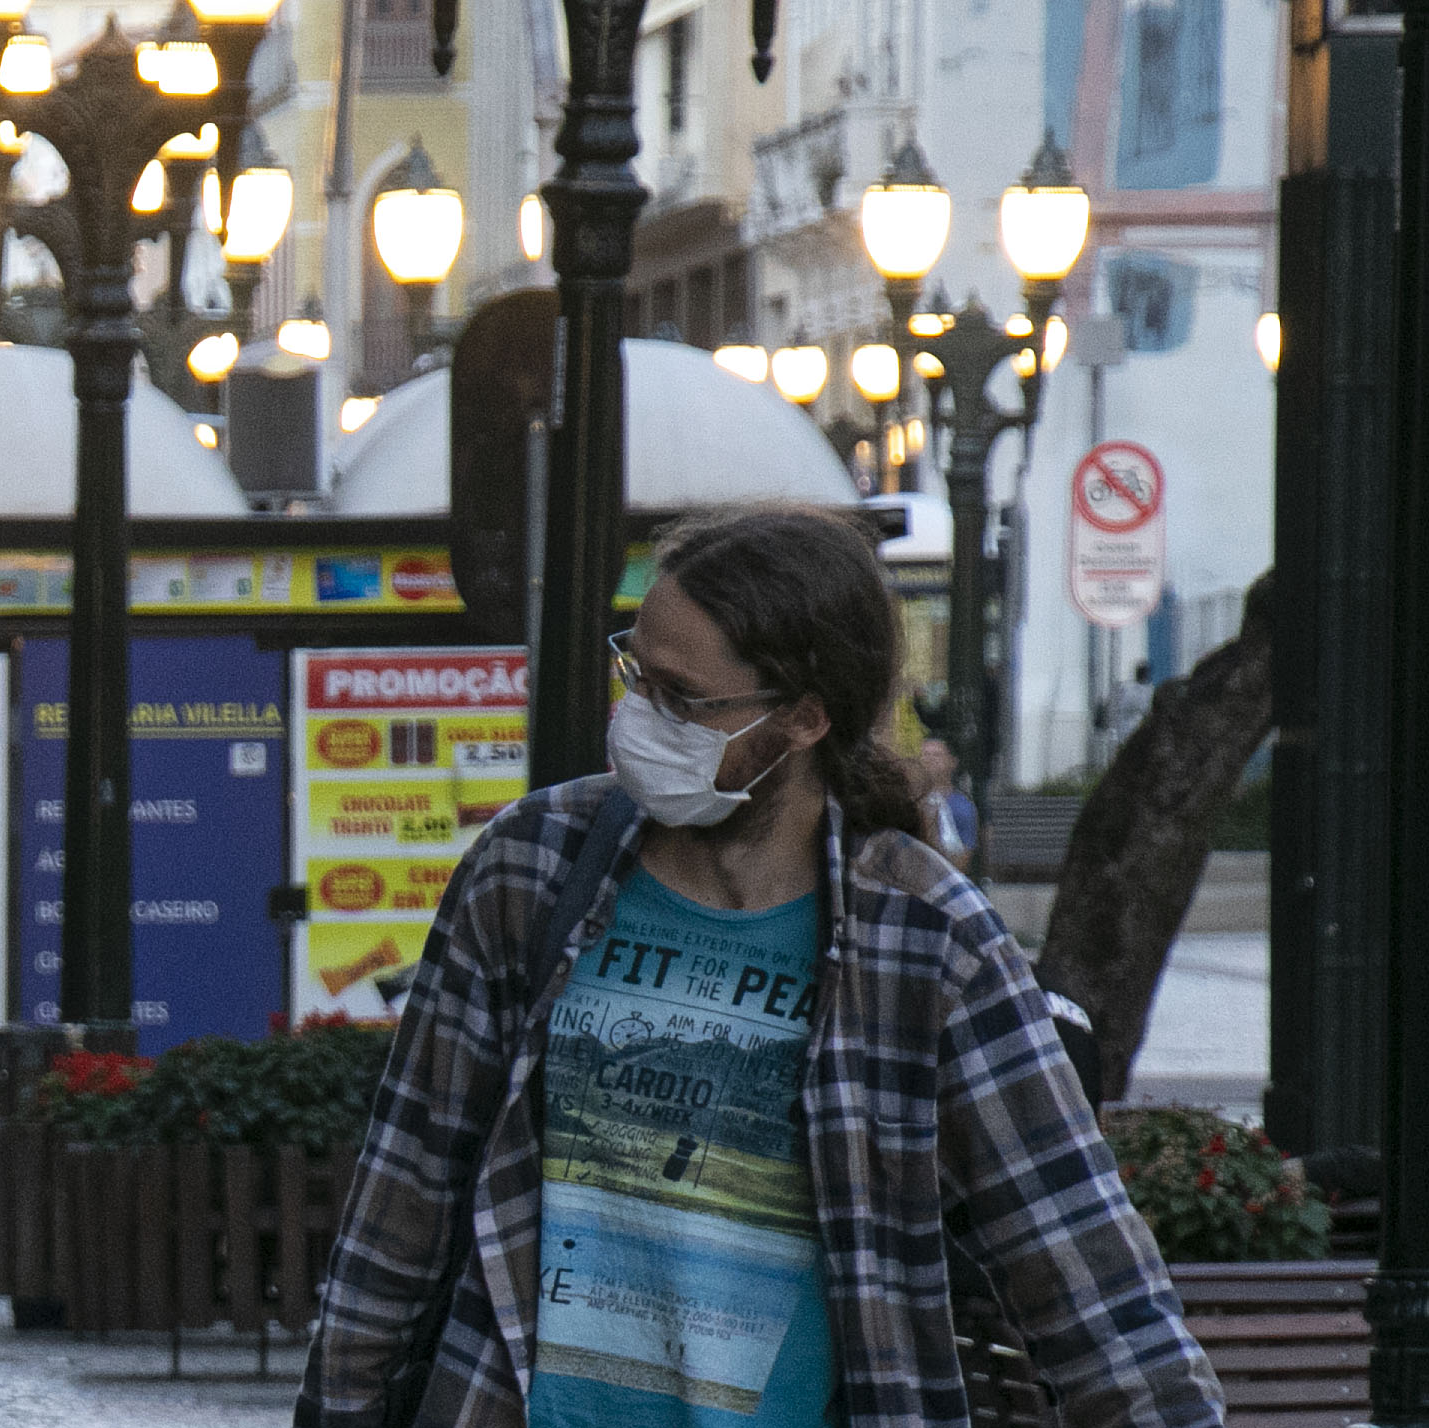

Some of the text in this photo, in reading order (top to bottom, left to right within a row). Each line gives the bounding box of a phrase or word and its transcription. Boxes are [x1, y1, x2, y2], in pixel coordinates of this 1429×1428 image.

[182, 702, 283, 726] VILELLA
[597, 937, 685, 989] FIT
[690, 954, 731, 981] FOR
[686, 975, 726, 1001] THE
[666, 1011, 732, 1042] AIM FOR
[596, 1060, 714, 1109] CARDIO
